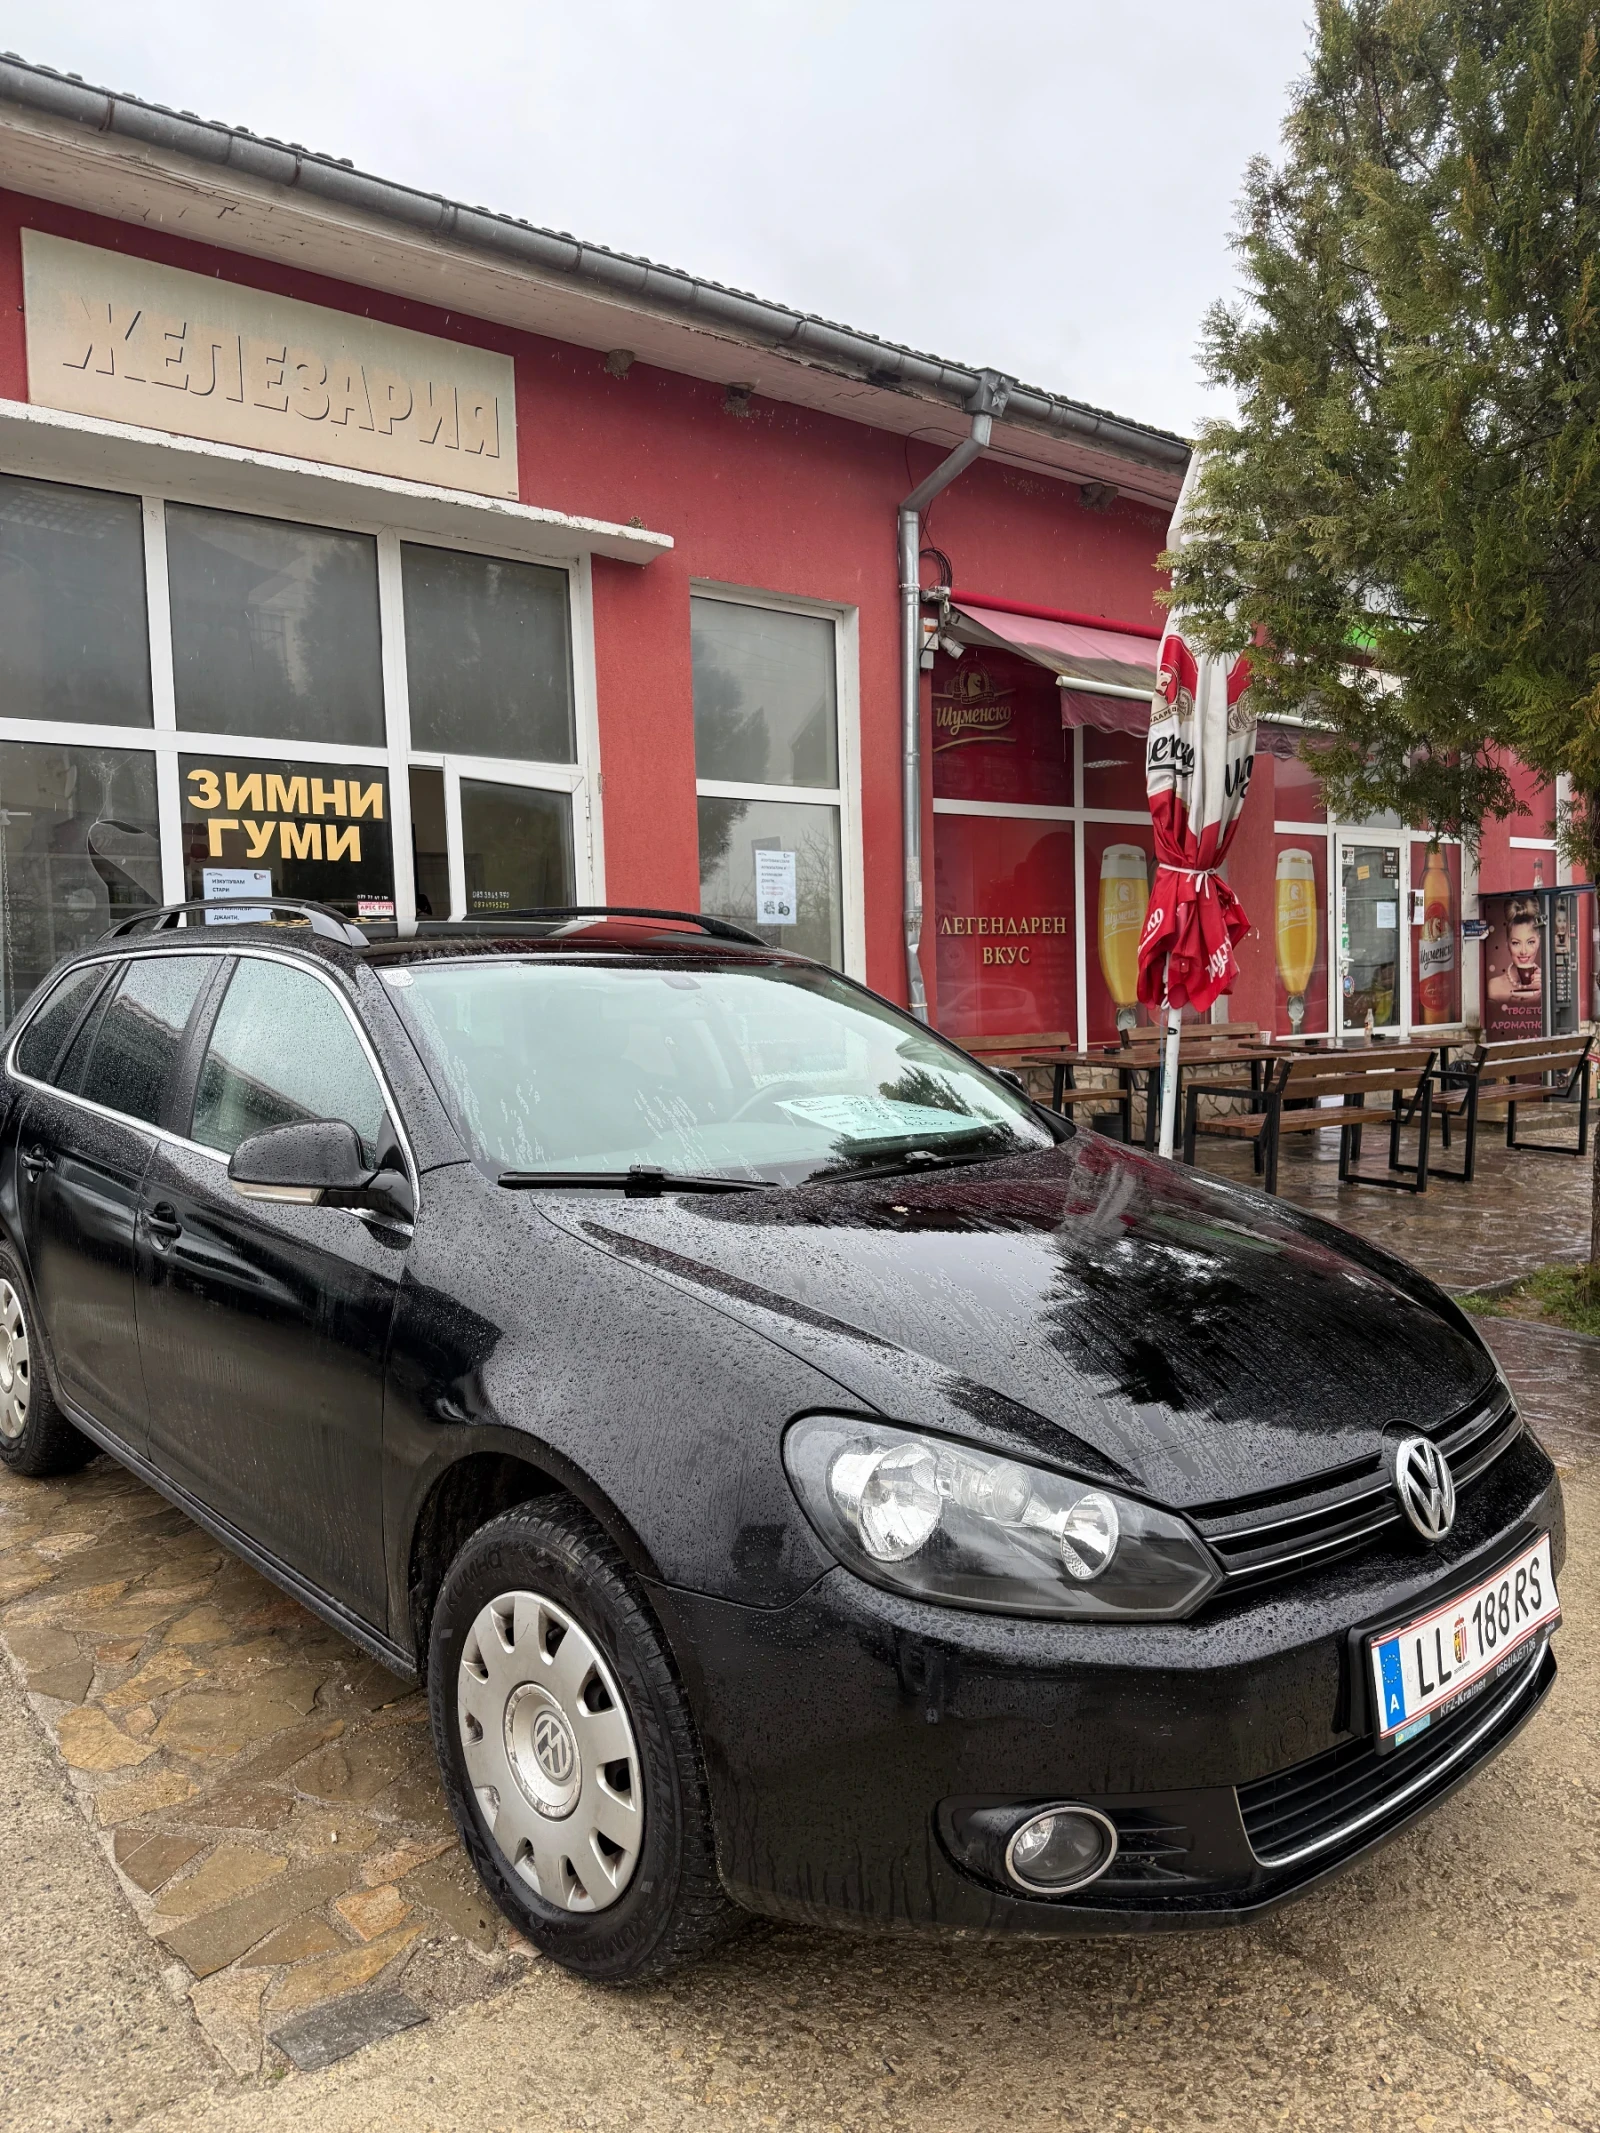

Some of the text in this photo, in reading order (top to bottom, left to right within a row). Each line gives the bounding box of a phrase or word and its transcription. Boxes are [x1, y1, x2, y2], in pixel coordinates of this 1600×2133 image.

[60, 293, 501, 459] ЖЕЛЕЗАРИЯ
[936, 706, 1012, 736] Шуменско
[187, 768, 384, 820] ЗИМНИ
[207, 817, 362, 862] ГУМИ
[941, 916, 1067, 936] ЛЕГЕНДАРЕН
[982, 946, 1031, 965] ВКУС
[1416, 1627, 1452, 1697] LL
[1389, 1693, 1400, 1715] A
[1440, 1679, 1487, 1718] KFZ-Krainer
